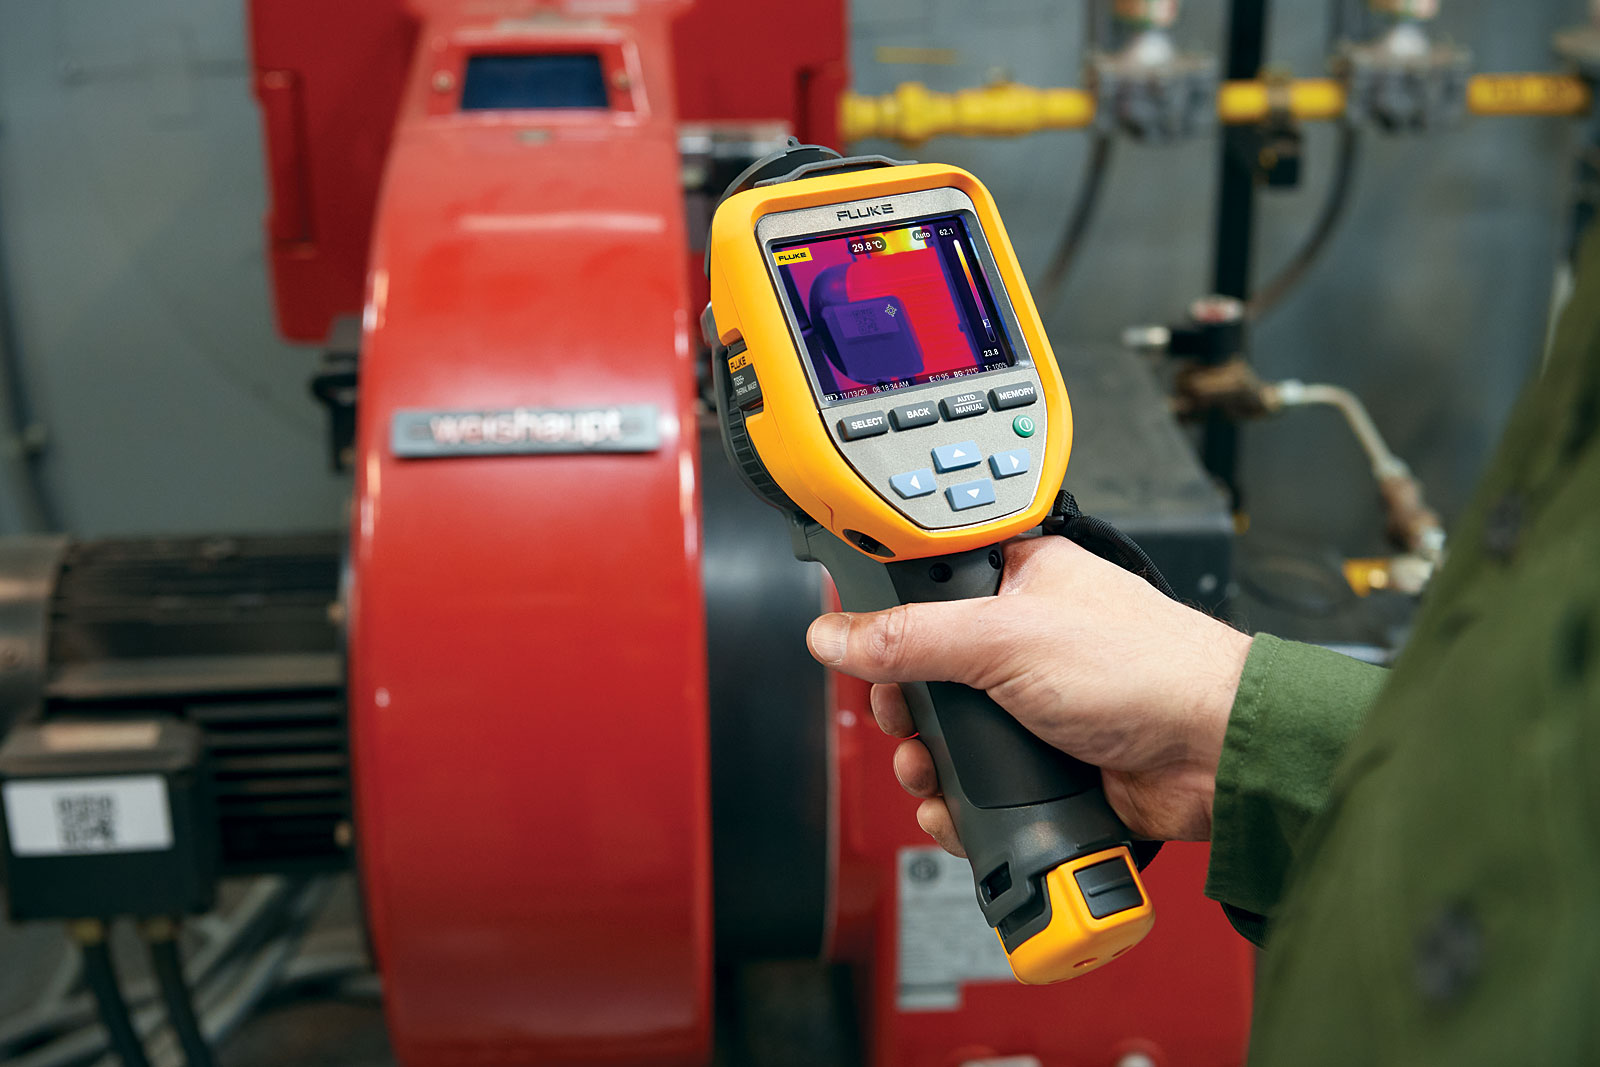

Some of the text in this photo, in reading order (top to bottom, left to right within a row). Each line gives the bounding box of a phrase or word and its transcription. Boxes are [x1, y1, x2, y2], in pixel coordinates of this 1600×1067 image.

[836, 203, 895, 221] FLUKE
[915, 231, 931, 240] Auto
[939, 228, 954, 236] 62.1
[778, 252, 807, 261] FLUKE
[983, 348, 999, 357] 23.8
[730, 356, 746, 370] FLUKE
[840, 388, 868, 399] 11/13/20
[957, 393, 976, 403] AUTO
[999, 385, 1035, 401] MEMORY
[906, 407, 931, 419] BACK
[955, 402, 985, 415] MANUAL
[430, 407, 622, 444] weishaupt
[851, 416, 883, 430] SELECT
